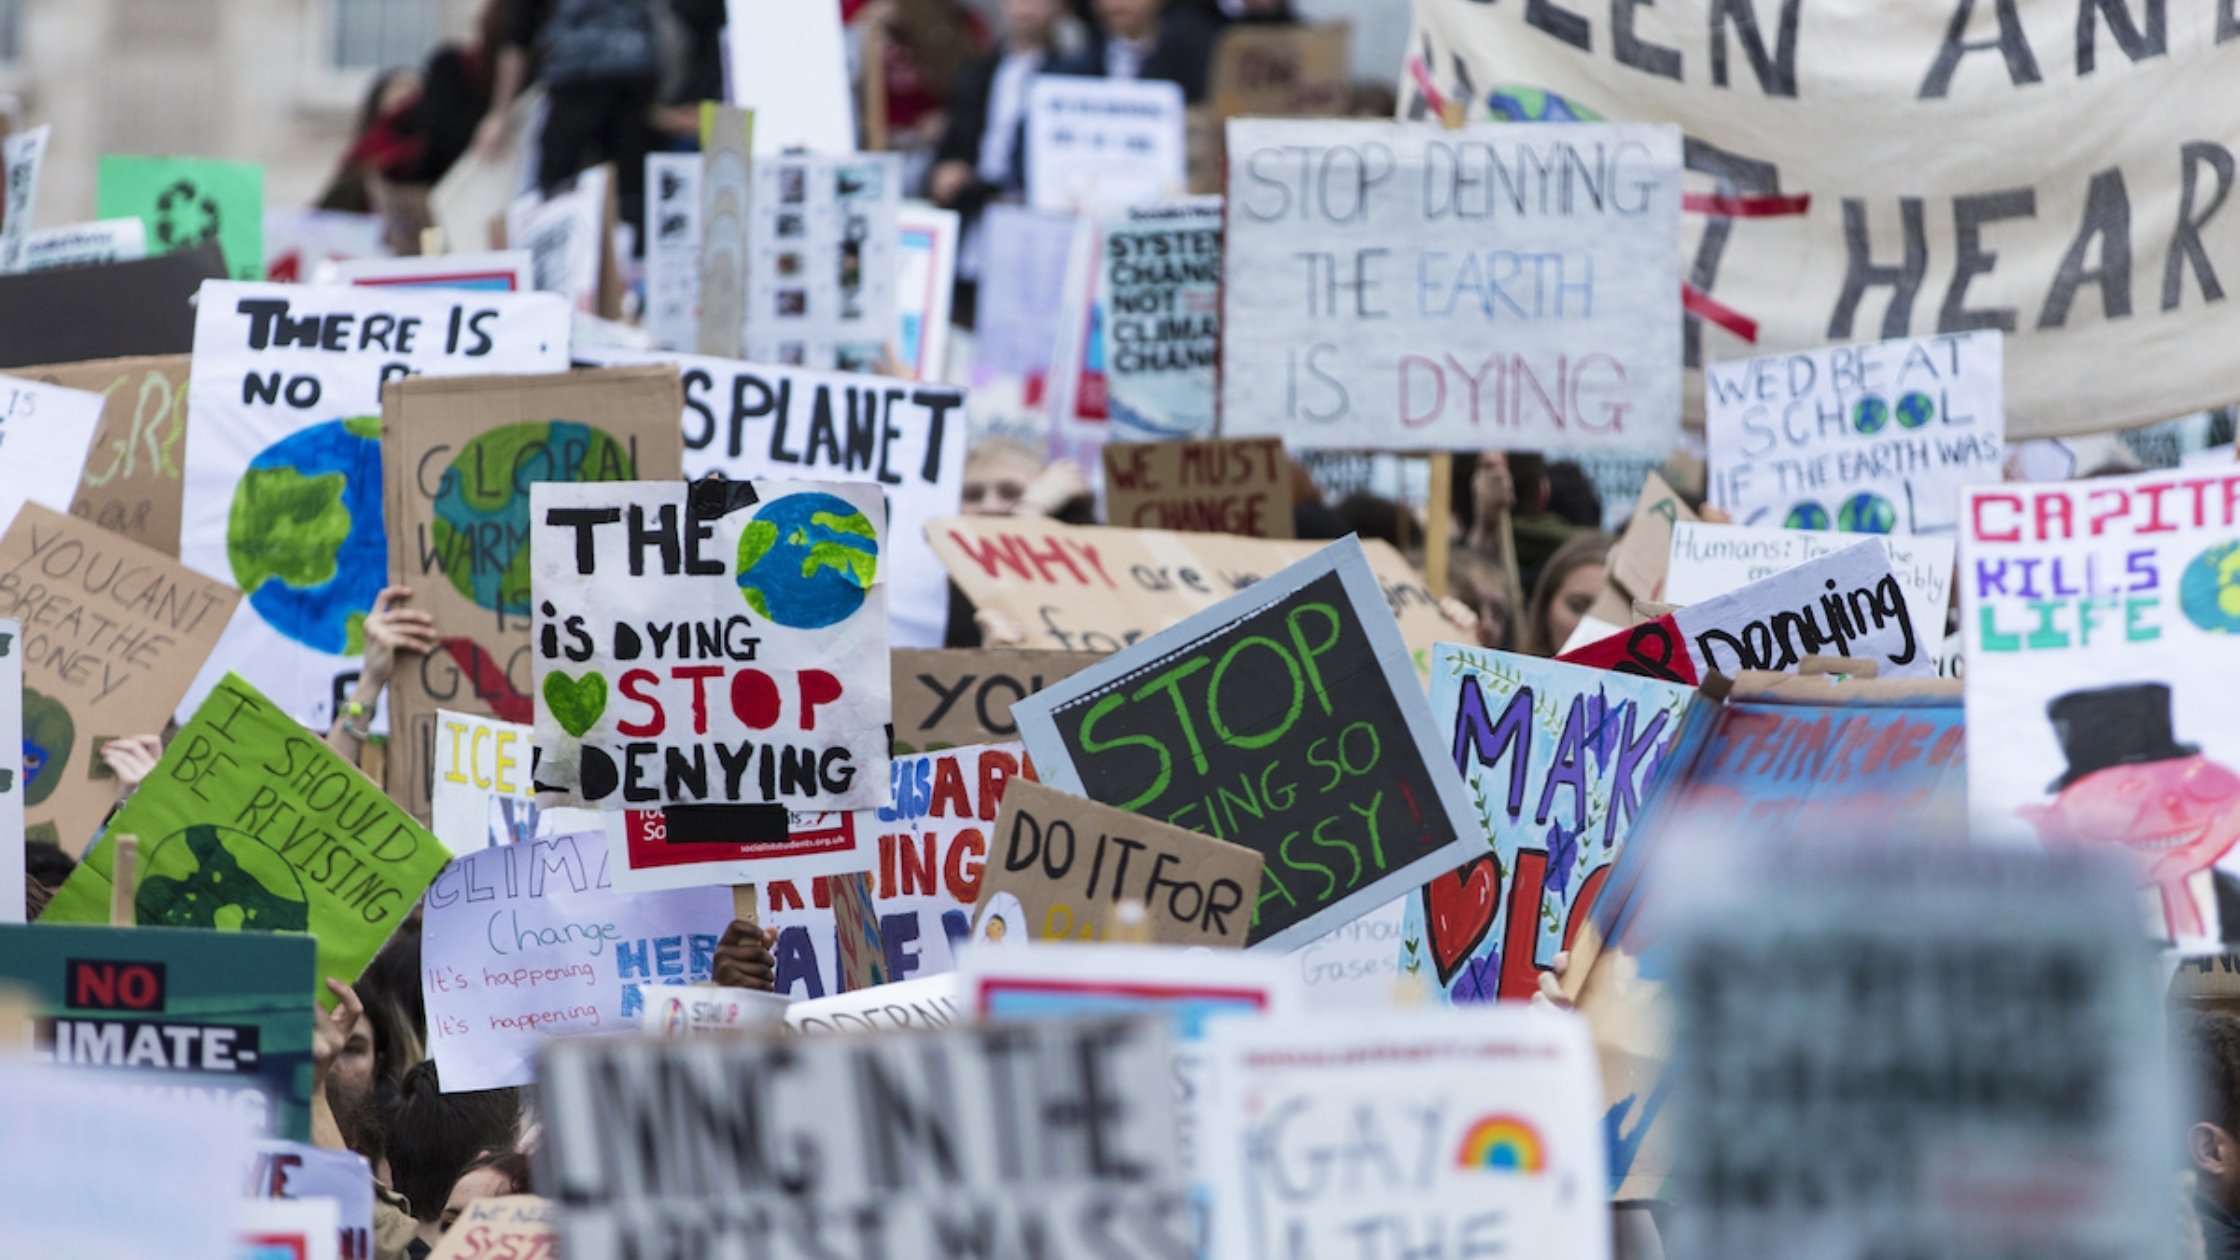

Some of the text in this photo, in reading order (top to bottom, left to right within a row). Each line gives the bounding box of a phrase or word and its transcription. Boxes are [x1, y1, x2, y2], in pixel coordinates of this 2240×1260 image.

[1917, 0, 2240, 100] AN
[1242, 140, 1660, 226] STOP DENYING
[1297, 248, 1595, 320] THE EARTH
[237, 298, 500, 357] THERE IS
[242, 369, 321, 409] NO
[1287, 342, 1634, 433] IS DYING
[1830, 345, 1886, 398] BE
[1896, 333, 1972, 382] AT
[728, 373, 963, 486] PLANET
[1105, 446, 1159, 491] WE
[1179, 439, 1281, 487] MUST
[1714, 463, 1754, 509] IF
[1769, 458, 1830, 495] THE
[1836, 439, 1931, 482] EARTH
[1935, 432, 2000, 467] WAS
[418, 522, 531, 577] WARM
[545, 503, 726, 576] THE
[948, 527, 1118, 592] WHY
[613, 613, 762, 661] DYING
[1694, 571, 1917, 666] Denying
[1977, 597, 2161, 652] LIFE
[22, 621, 132, 707] ONEY
[615, 665, 843, 738] STOP
[916, 673, 1044, 736] YO
[1078, 601, 1342, 812] STOP
[444, 722, 517, 794] ICE
[579, 739, 856, 802] DENYING
[1306, 721, 1381, 793] SO
[170, 733, 404, 926] BE REVISING
[262, 736, 418, 865] SHOULD
[1004, 808, 1076, 880] DO
[1085, 833, 1147, 904] IT
[1144, 853, 1244, 936] FOR
[487, 909, 622, 957] Change
[75, 962, 158, 1009] NO
[428, 961, 597, 993] It's happening
[434, 1003, 600, 1040] It's happening
